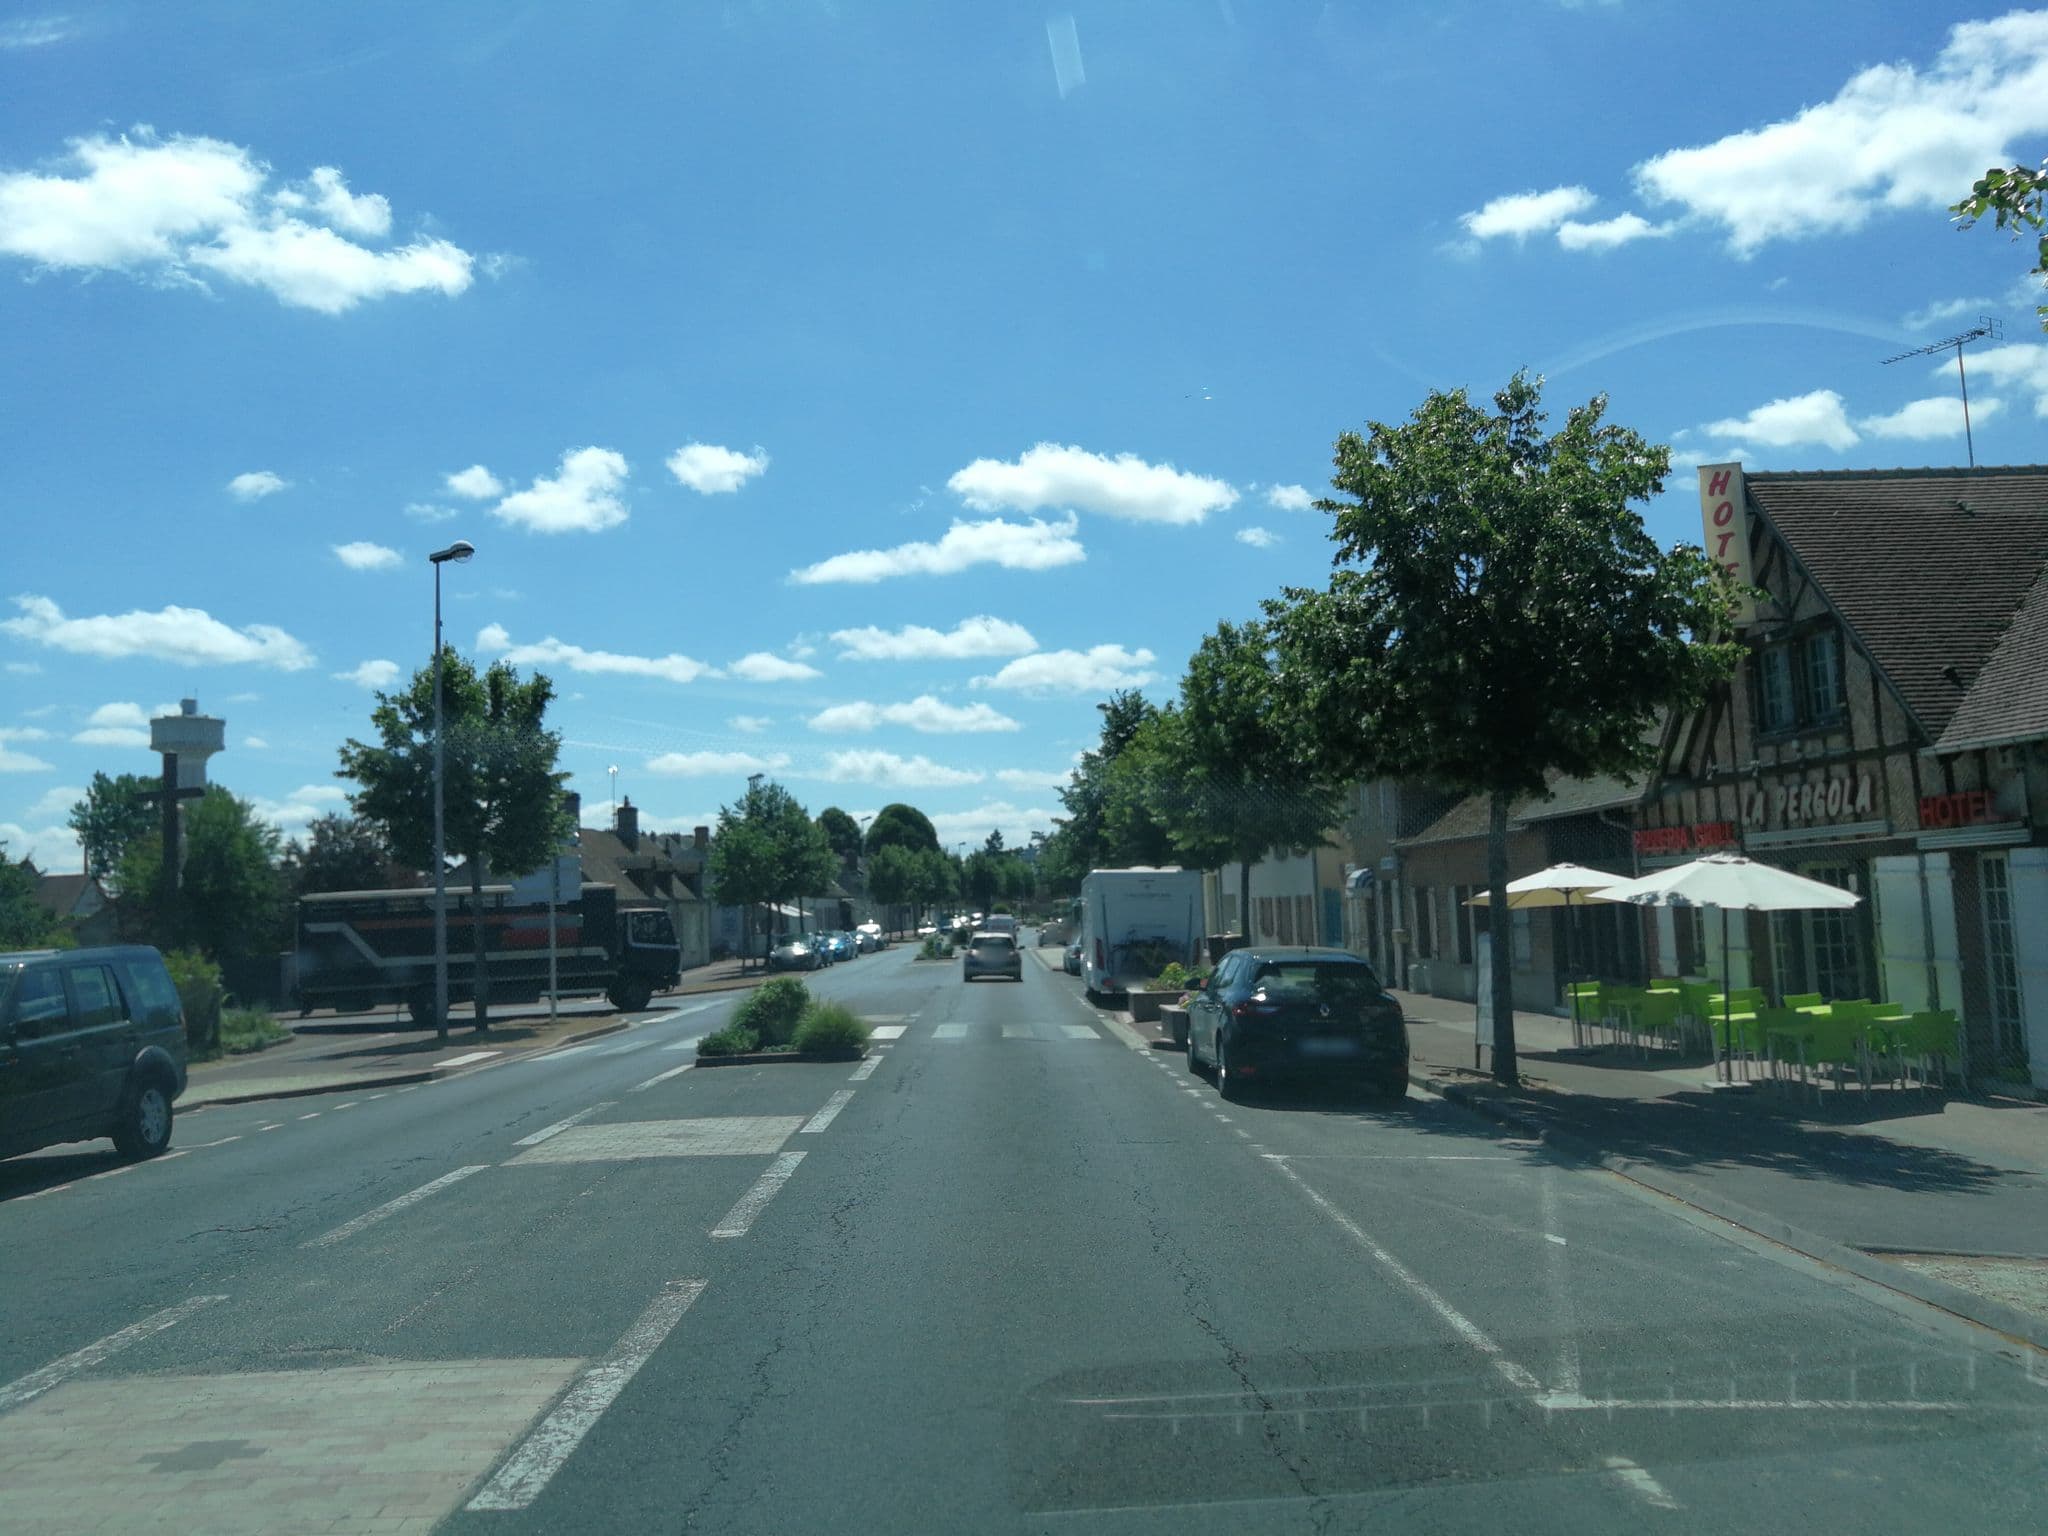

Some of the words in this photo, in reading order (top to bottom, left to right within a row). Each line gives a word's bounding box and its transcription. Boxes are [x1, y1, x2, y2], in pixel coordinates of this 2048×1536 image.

[1708, 469, 1743, 620] HOT
[1741, 790, 1765, 826] LA
[1775, 774, 1872, 821] PERGOLA
[1919, 789, 2006, 827] HOTEL
